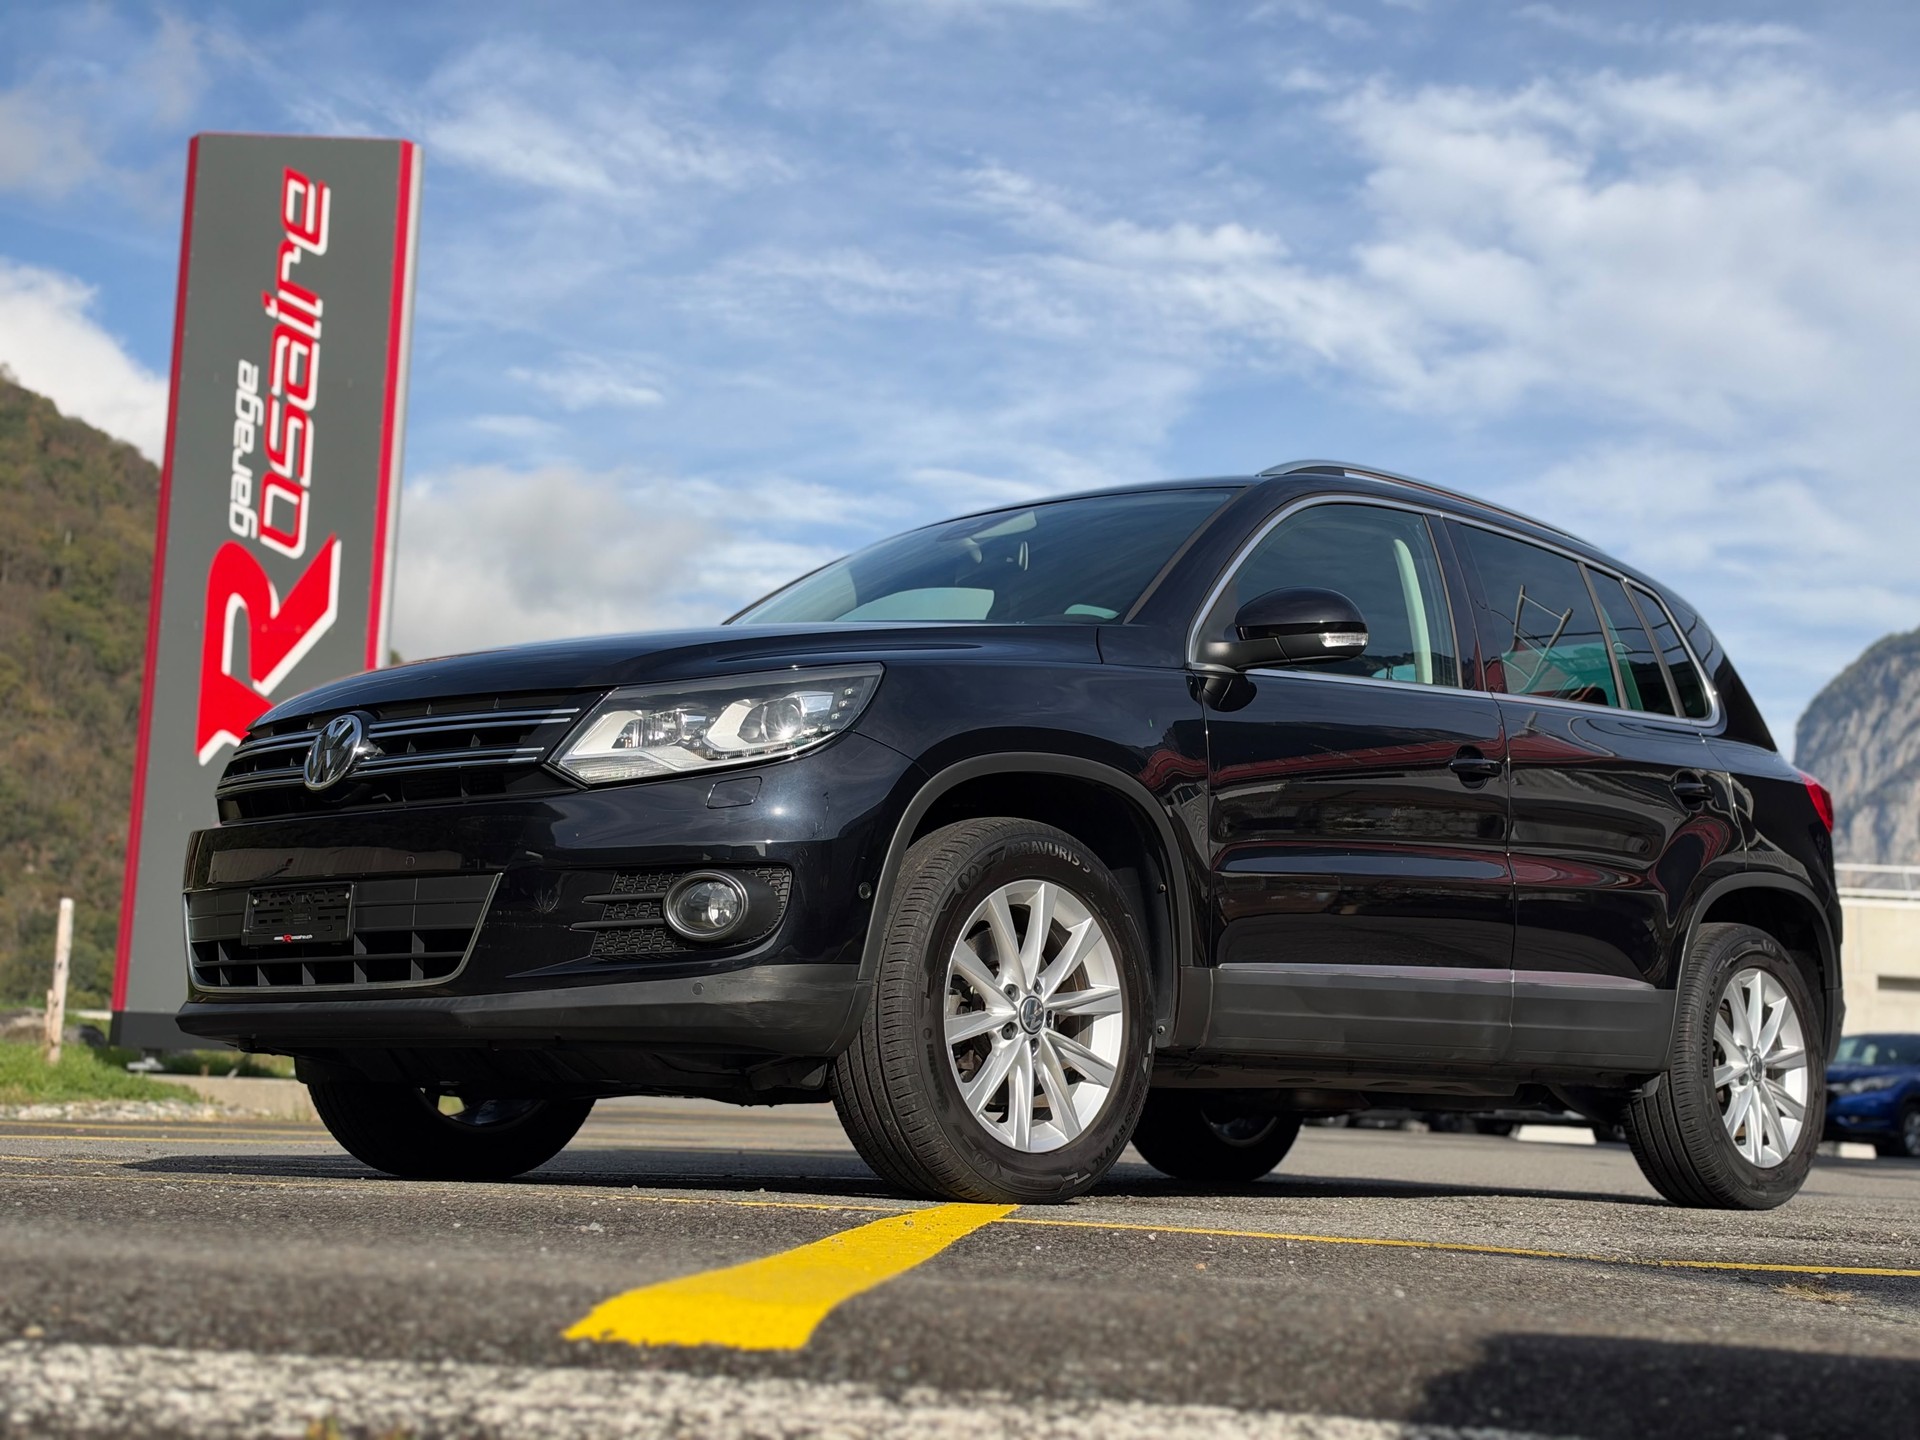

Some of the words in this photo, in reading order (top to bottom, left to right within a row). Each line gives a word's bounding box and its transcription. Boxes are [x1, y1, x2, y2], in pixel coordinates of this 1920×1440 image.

[229, 359, 263, 538] garage
[1008, 840, 1081, 866] BRAVURIS
[1702, 1000, 1713, 1079] BRAVURIS
